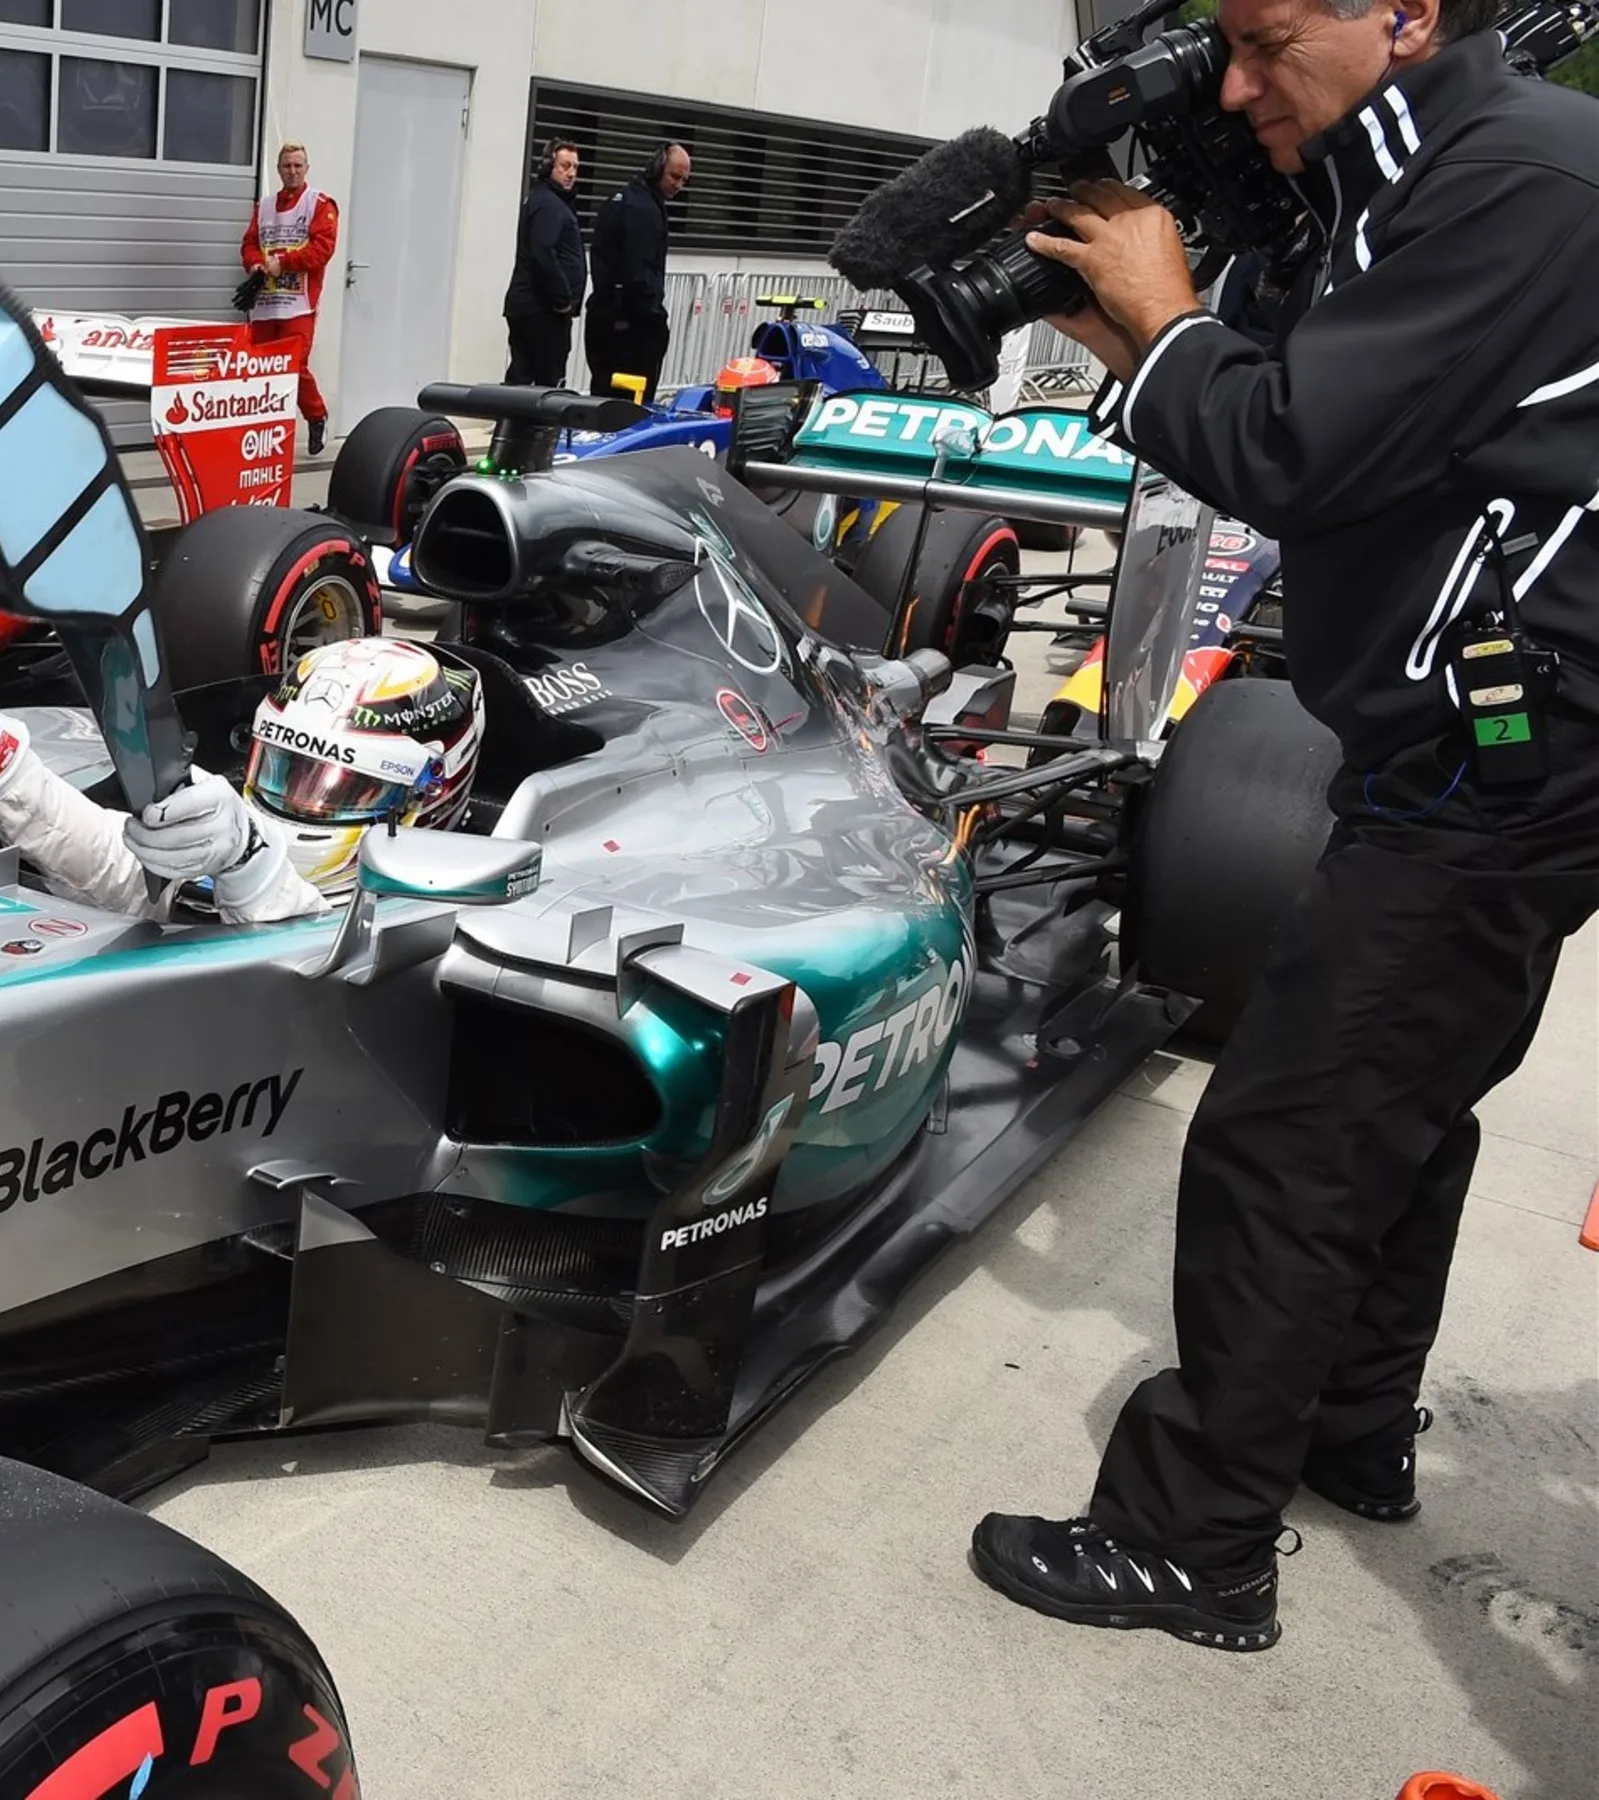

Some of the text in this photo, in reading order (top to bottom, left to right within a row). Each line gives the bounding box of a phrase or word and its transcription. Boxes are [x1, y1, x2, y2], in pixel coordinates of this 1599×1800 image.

[311, 0, 353, 36] MC
[870, 314, 913, 328] Saub
[216, 354, 292, 377] V-Power
[191, 382, 287, 422] Santander
[811, 398, 1136, 466] PETRONA
[239, 464, 283, 489] MAHLE
[522, 662, 602, 708] BOSS
[258, 719, 357, 765] PETRONAS
[1493, 719, 1512, 741] 2
[380, 760, 416, 777] EPSON
[660, 1197, 769, 1252] PETRONAS
